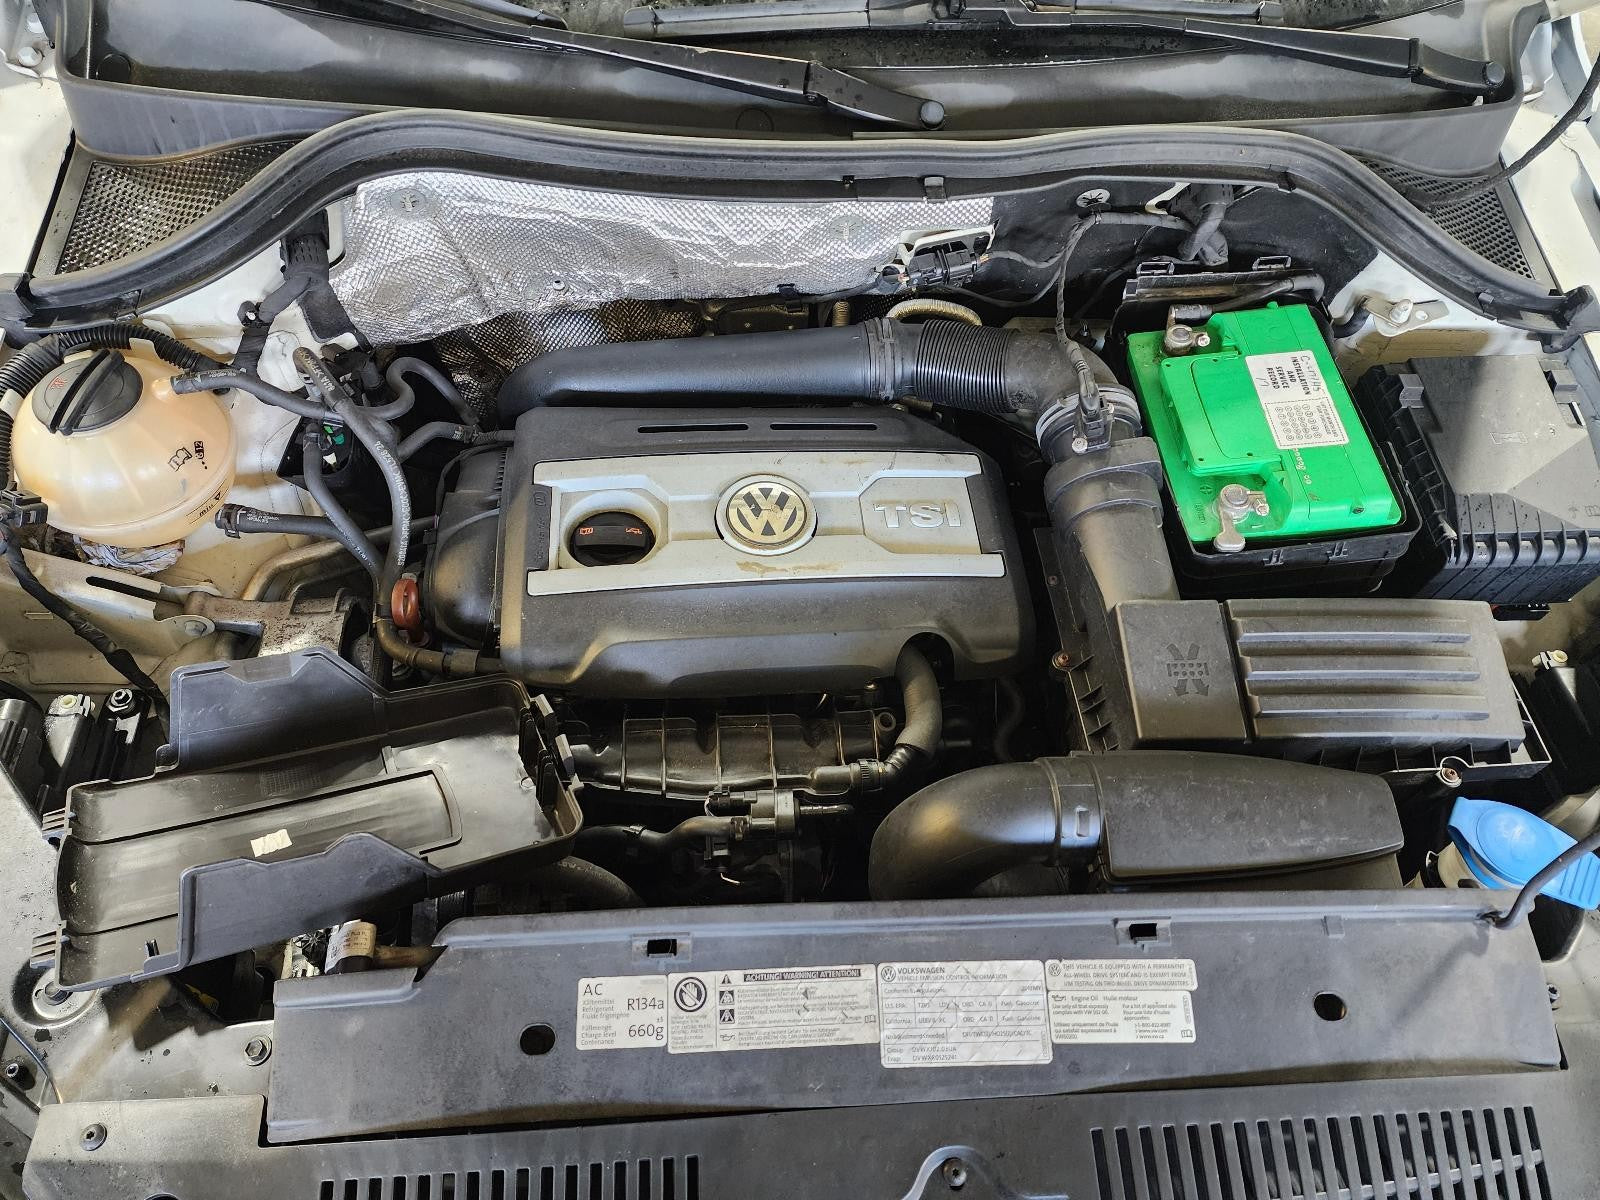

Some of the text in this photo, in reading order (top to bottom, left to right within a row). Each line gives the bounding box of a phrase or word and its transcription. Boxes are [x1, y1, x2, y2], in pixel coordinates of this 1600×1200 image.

[1266, 367, 1280, 389] RECORD
[1275, 366, 1290, 389] SERVICE
[1286, 370, 1297, 382] AND
[1290, 356, 1311, 395] INSTALLATION
[873, 502, 961, 528] TSI
[745, 972, 781, 982] ACHTUNG!
[820, 970, 859, 978] ATTENTION!
[583, 983, 603, 996] AC
[627, 997, 664, 1010] R134a
[628, 1024, 664, 1040] 660g
